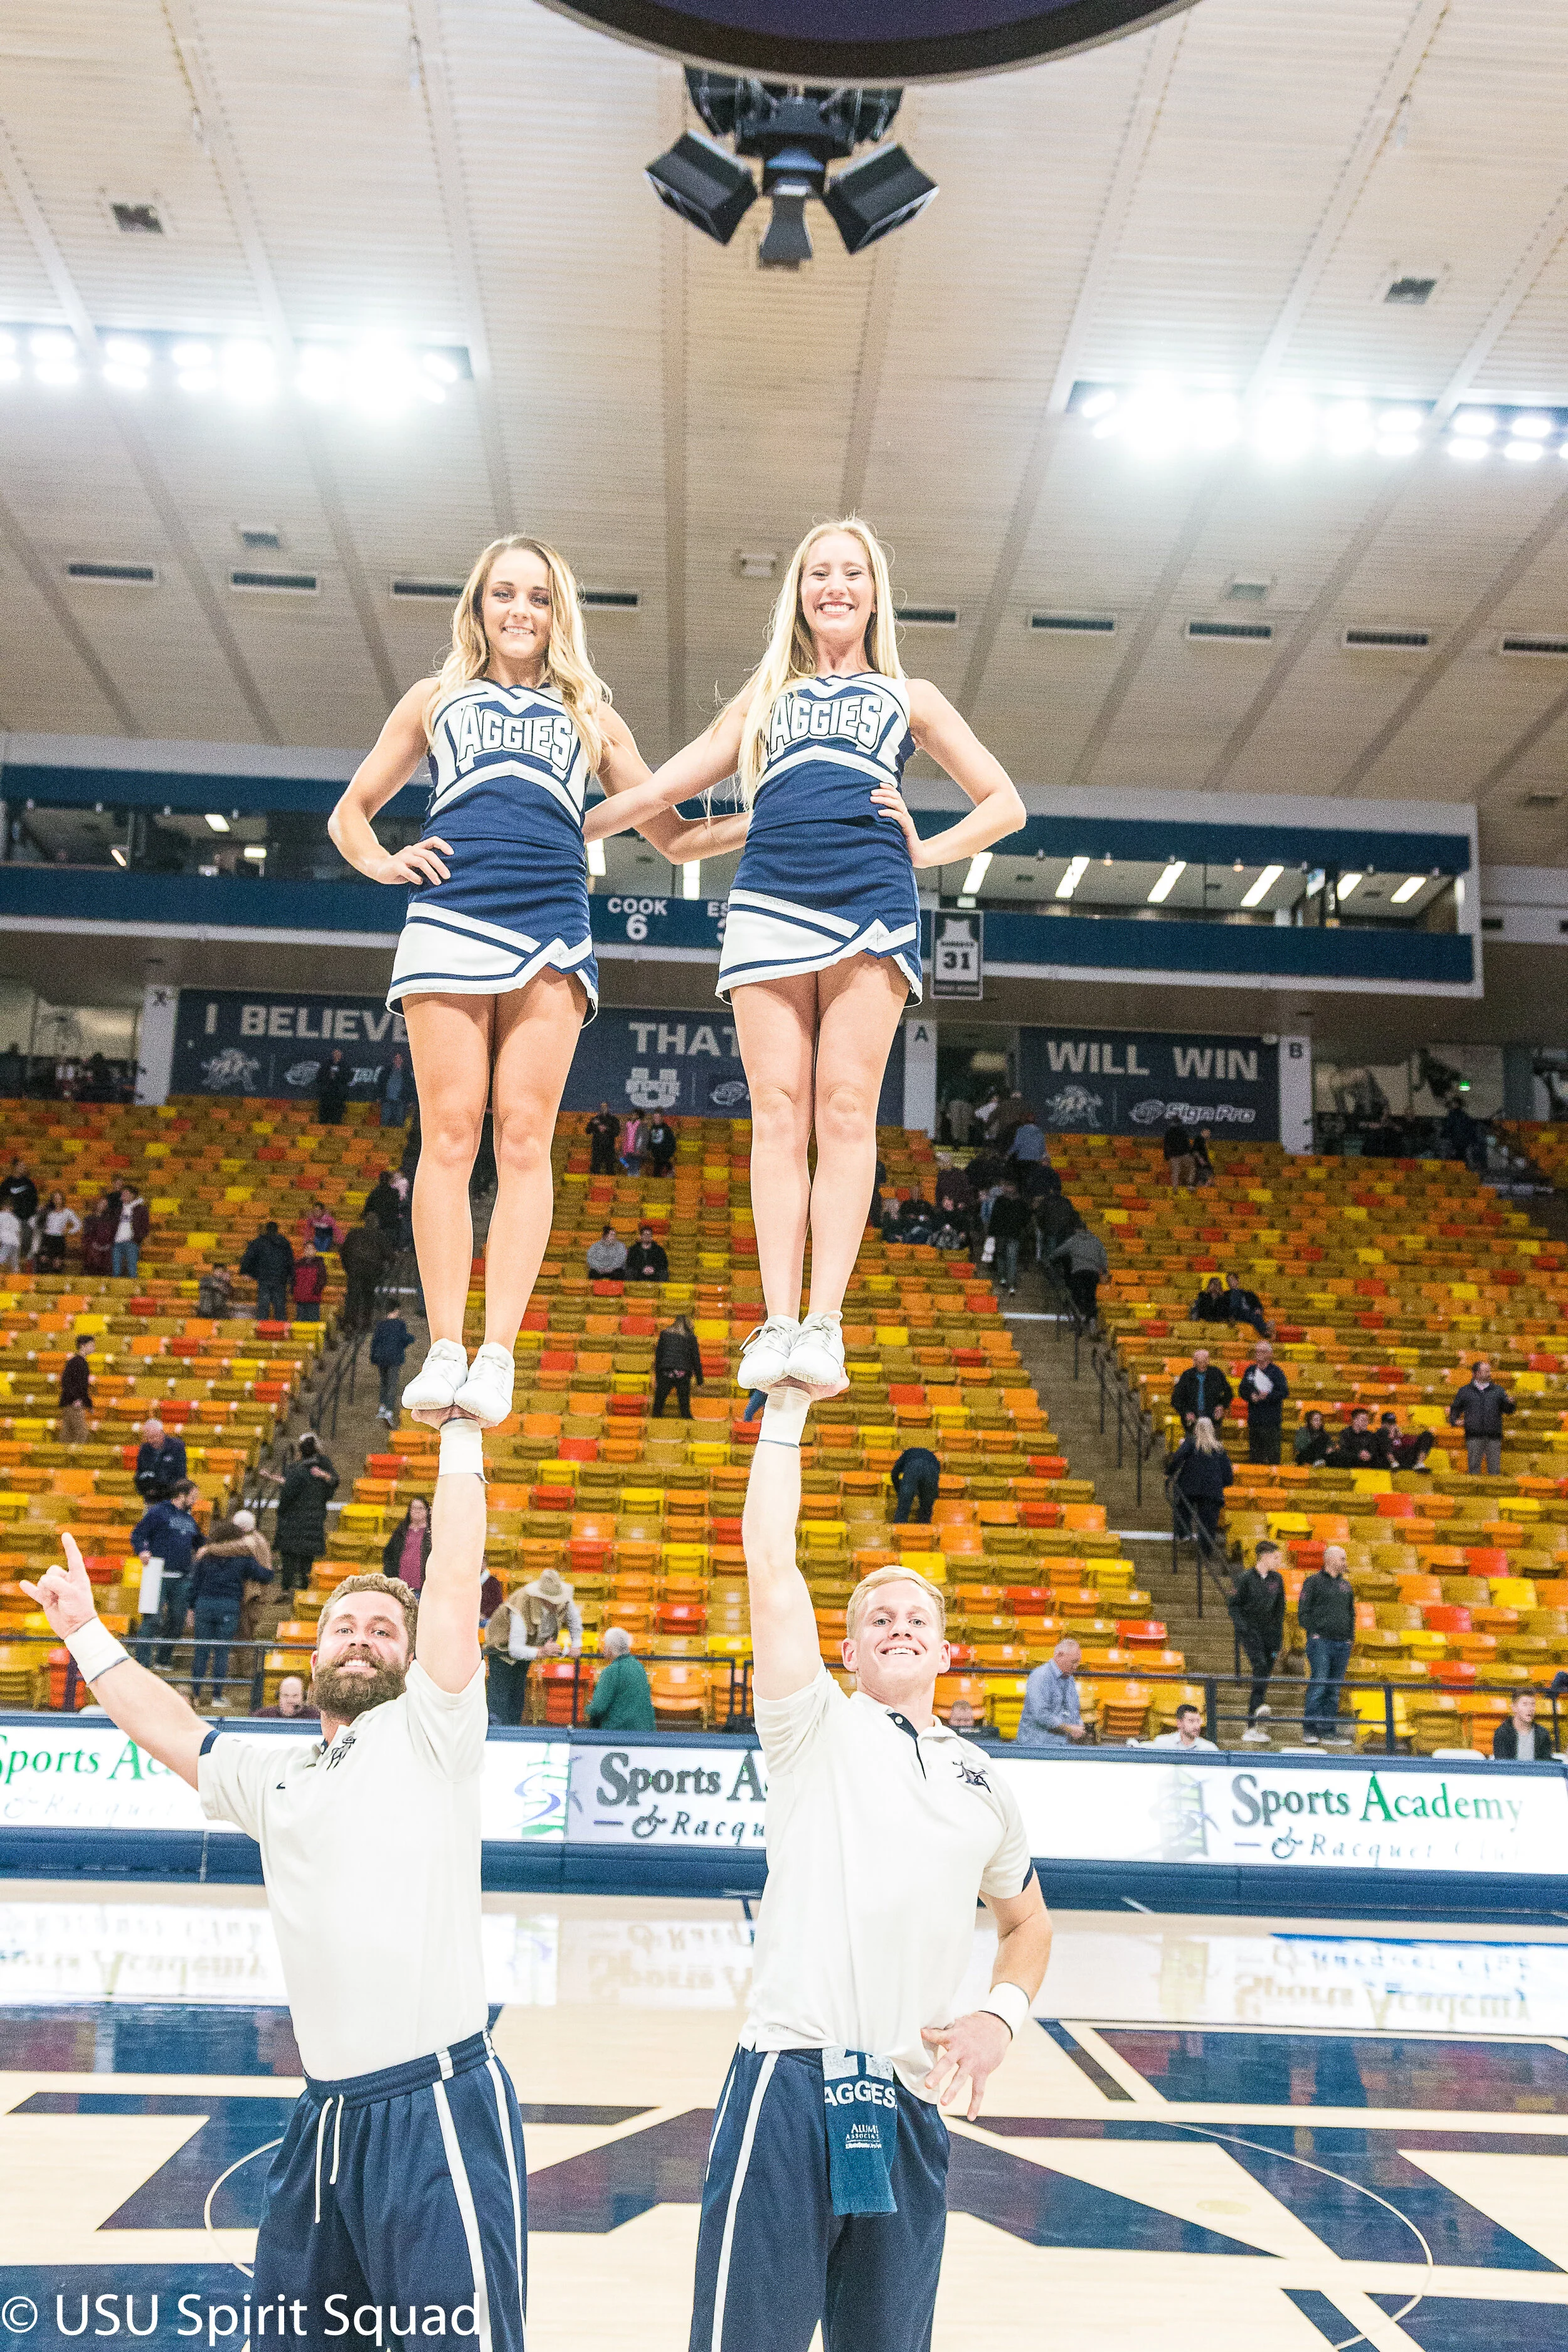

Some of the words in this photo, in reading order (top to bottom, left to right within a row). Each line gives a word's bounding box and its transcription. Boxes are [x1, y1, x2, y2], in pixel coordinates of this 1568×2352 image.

[457, 704, 573, 771] AGGIES
[769, 695, 882, 755] AGGIES
[608, 898, 667, 916] COOK
[627, 913, 648, 941] 6
[943, 951, 970, 970] 31
[206, 1003, 218, 1035] I
[914, 1025, 928, 1042] A
[629, 1022, 740, 1057] THAT
[1289, 1042, 1303, 1059] B
[1047, 1041, 1150, 1076] WILL
[1173, 1046, 1258, 1081] WIN
[0, 1734, 100, 1785] ports
[596, 1752, 721, 1806] Sports
[727, 1749, 766, 1802] A
[1232, 1774, 1350, 1826] Sports
[1359, 1771, 1523, 1832] Academy
[632, 1804, 667, 1839] &
[1271, 1826, 1303, 1859] &
